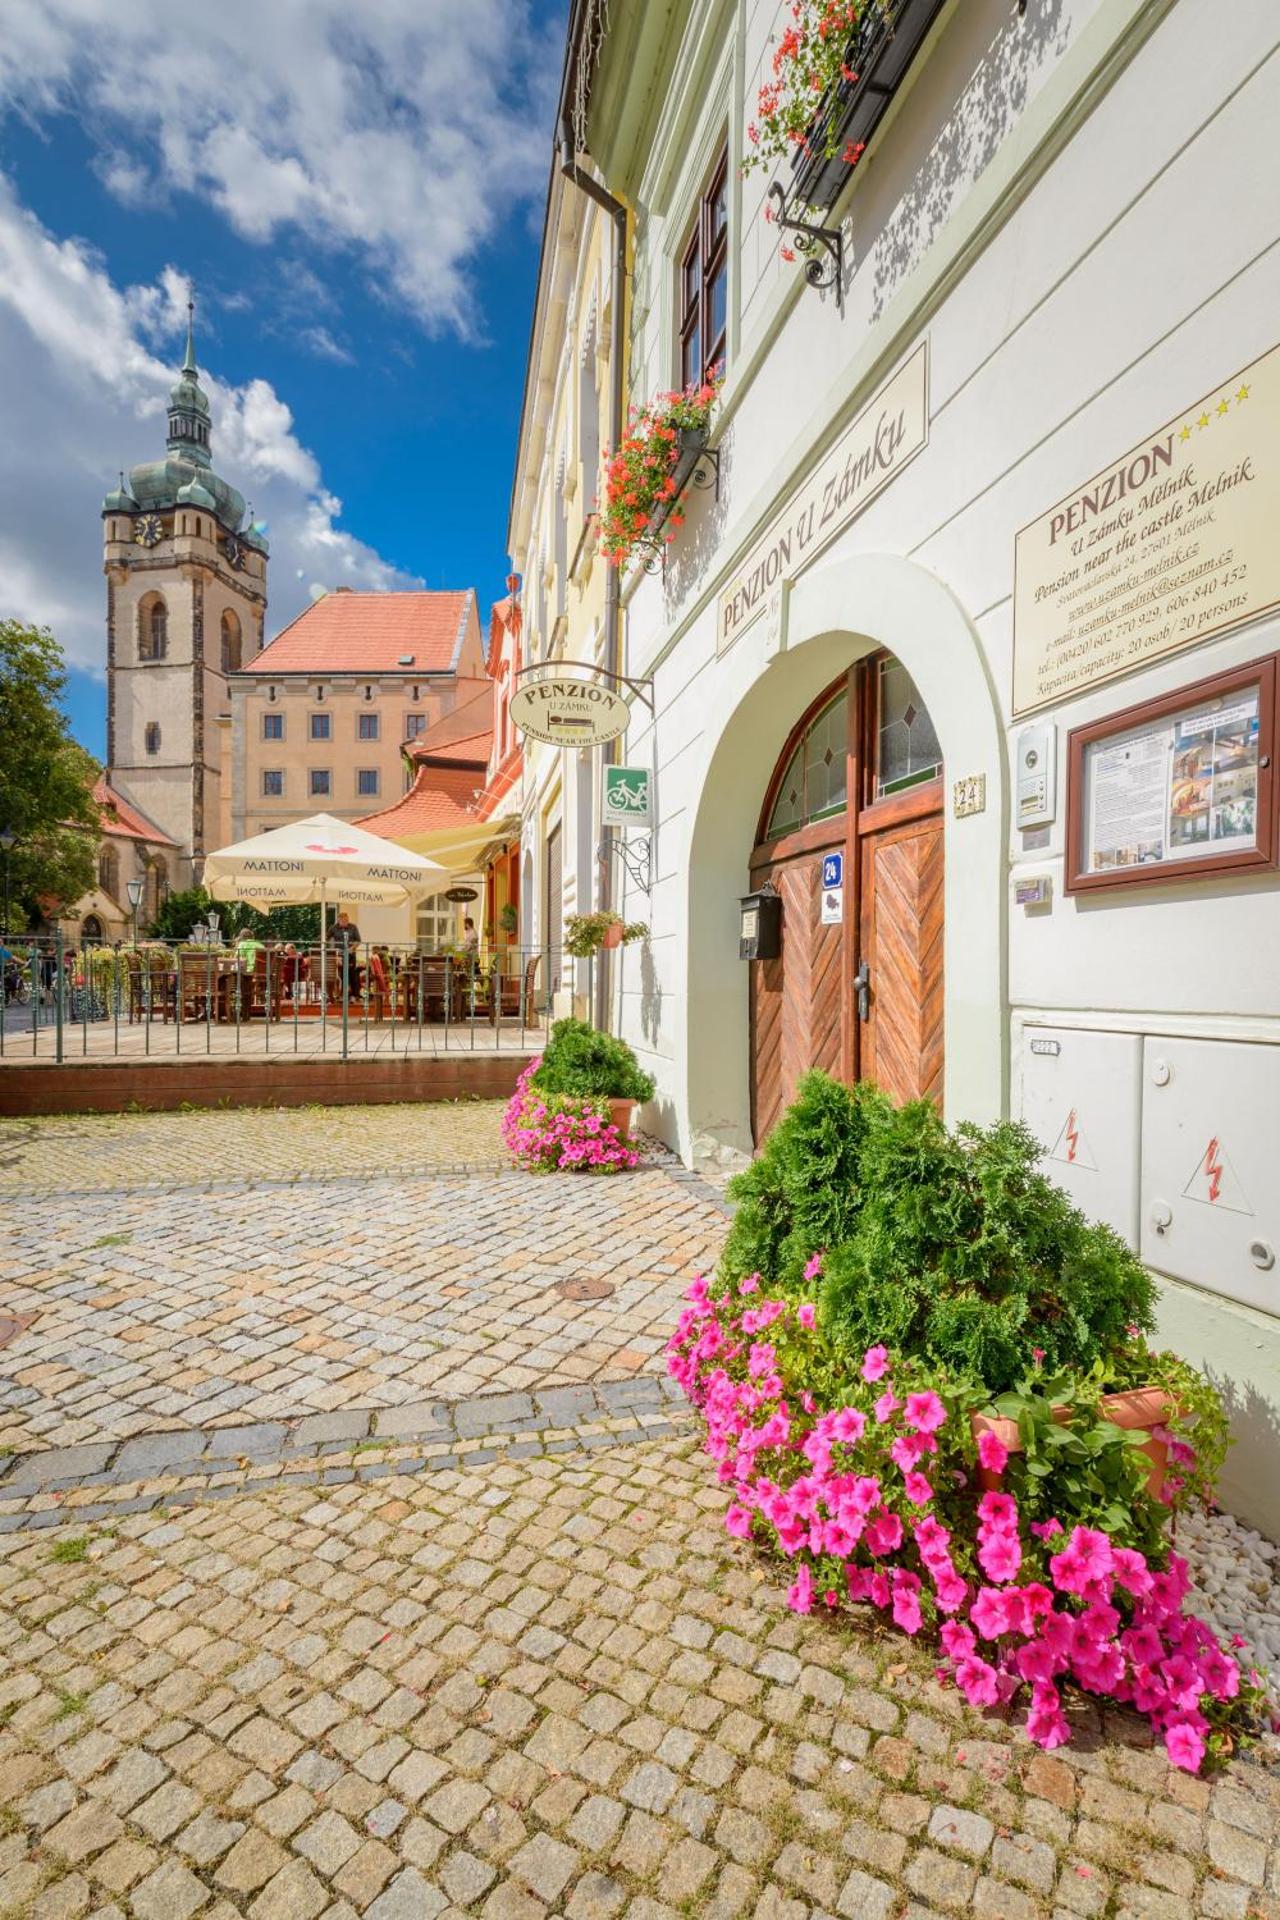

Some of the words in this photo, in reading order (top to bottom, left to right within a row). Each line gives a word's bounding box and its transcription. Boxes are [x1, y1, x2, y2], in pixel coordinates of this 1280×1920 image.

[1048, 433, 1175, 546] PENZION
[1071, 537, 1083, 556] U
[1087, 507, 1134, 547] Zámku
[1137, 463, 1197, 516] Mělník
[724, 528, 792, 637] PENZION
[796, 501, 815, 550] U
[818, 409, 906, 529] Zámku
[1035, 567, 1079, 603] Pension
[1084, 547, 1113, 574] near
[1116, 530, 1137, 555] the
[1141, 500, 1183, 540] castle
[1187, 456, 1255, 513] Melnik
[1166, 591, 1190, 614] 606
[1193, 578, 1217, 602] 840
[1221, 564, 1247, 588] 452
[1128, 638, 1142, 654] 20
[1179, 614, 1195, 631] 20
[1197, 592, 1248, 630] persons
[524, 683, 617, 711] PENZION
[960, 785, 976, 805] 24
[243, 861, 304, 872] MATTONI
[367, 868, 422, 882] MATTONI
[825, 861, 837, 881] 24
